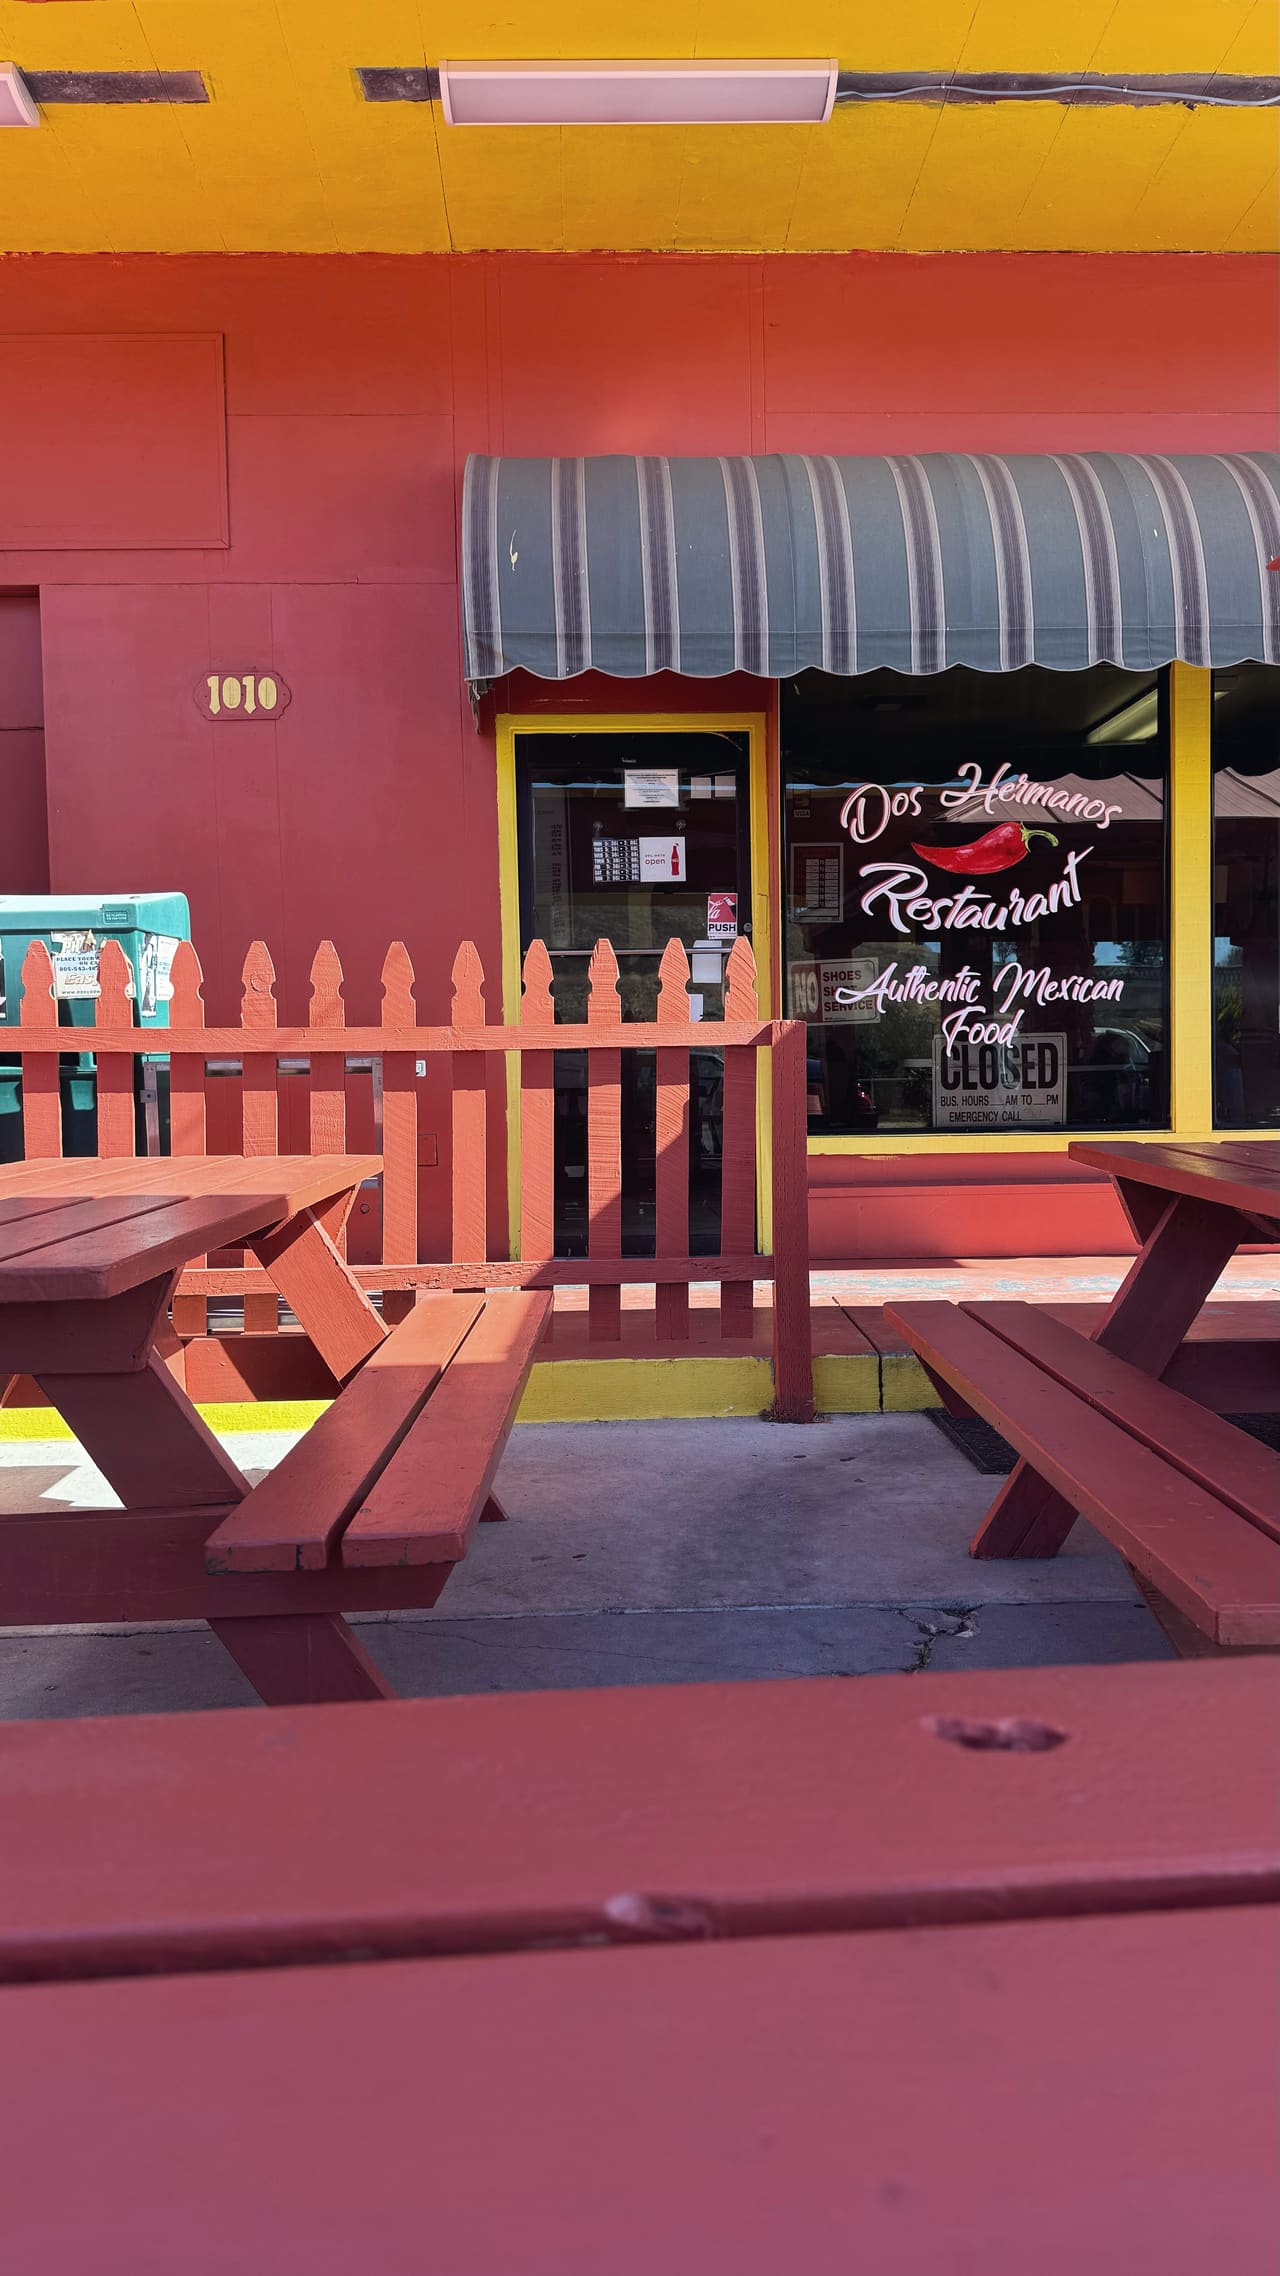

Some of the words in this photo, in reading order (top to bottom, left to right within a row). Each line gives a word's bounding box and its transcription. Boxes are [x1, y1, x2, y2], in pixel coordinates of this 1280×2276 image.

[207, 675, 277, 715] 1010
[840, 783, 924, 843] Dos
[940, 762, 1123, 829] Hermanos
[645, 858, 666, 866] open
[859, 846, 1094, 933] Restaurant
[709, 924, 736, 932] PUSH
[793, 971, 819, 1014] NO
[823, 970, 862, 981] SHOES
[836, 962, 982, 1013] Authentic
[993, 962, 1125, 1013] Mexican
[824, 1000, 873, 1012] SERVICE
[942, 1006, 1025, 1057] Food
[940, 1043, 1059, 1091] CLOSED
[940, 1095, 959, 1107] BUS.
[962, 1095, 990, 1106] HOURS
[1005, 1095, 1018, 1105] AM
[1021, 1095, 1033, 1105] TO
[1046, 1094, 1059, 1105] PM
[949, 1111, 999, 1122] EMERGENCY
[1002, 1111, 1021, 1121] CALL
